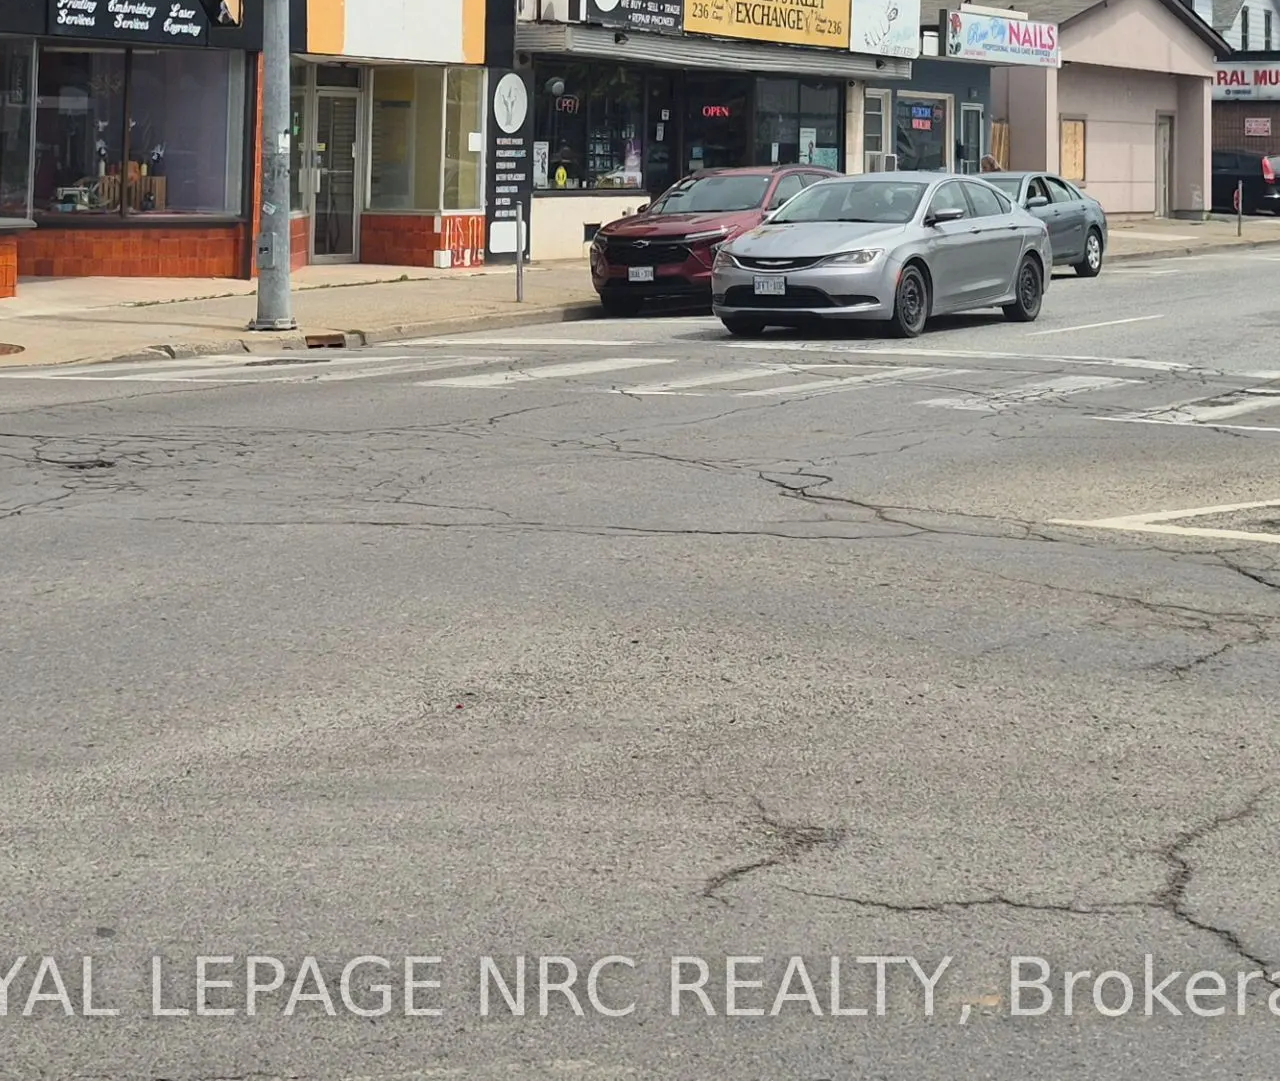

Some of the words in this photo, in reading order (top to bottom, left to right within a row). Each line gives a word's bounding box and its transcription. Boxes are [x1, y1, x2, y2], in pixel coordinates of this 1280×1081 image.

[692, 2, 708, 19] 236
[735, 2, 804, 30] EXCHANGE
[1009, 21, 1056, 50] NAILS
[702, 105, 729, 117] OPEN
